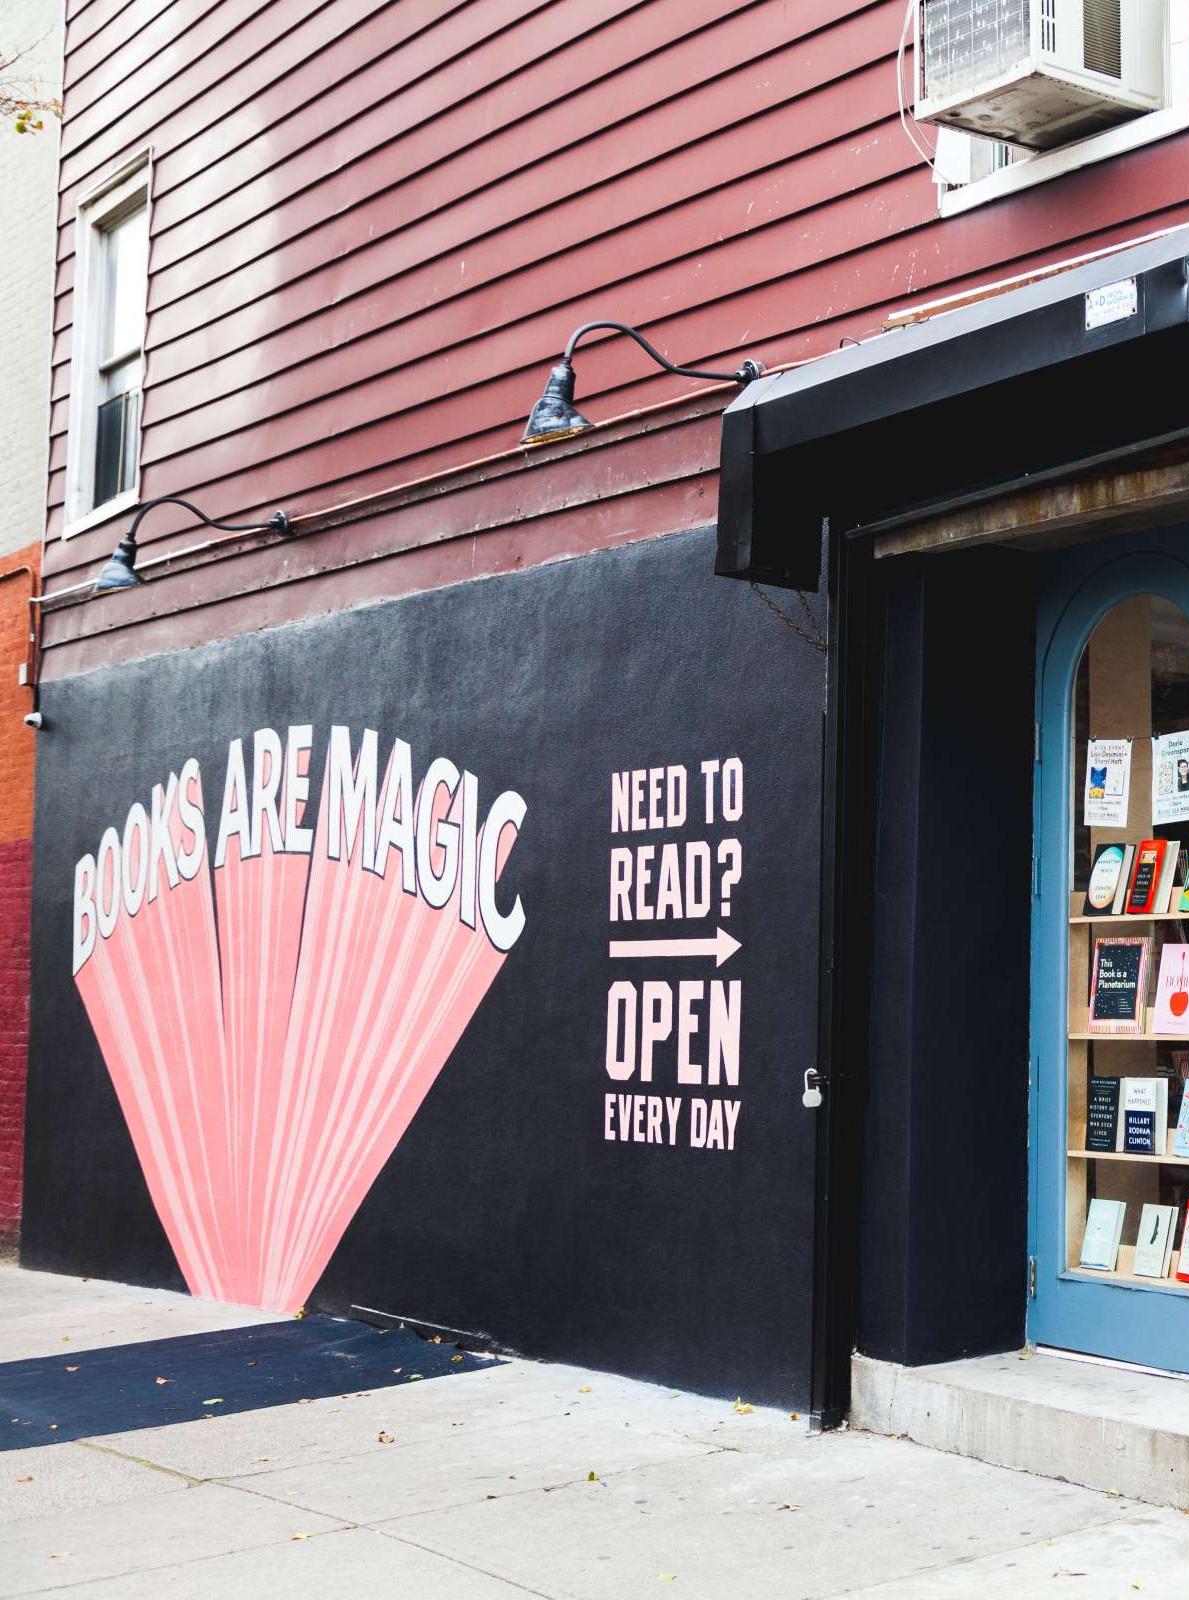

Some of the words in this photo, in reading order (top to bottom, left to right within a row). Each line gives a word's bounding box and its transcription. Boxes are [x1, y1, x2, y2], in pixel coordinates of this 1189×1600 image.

[611, 764, 687, 833] NEED
[701, 757, 743, 824] TO
[73, 758, 206, 976] BOOKS
[214, 725, 313, 868] ARE
[328, 725, 527, 951] MAGIC
[609, 838, 743, 922] READ?
[1099, 968, 1116, 978] Book
[1116, 969, 1122, 978] is
[1100, 958, 1113, 968] This
[1098, 979, 1136, 989] Planetarium
[605, 980, 741, 1085] OPEN
[604, 1093, 682, 1146] EVERY
[690, 1098, 741, 1151] DAY
[1128, 1116, 1150, 1125] HILLARY
[1128, 1137, 1151, 1146] CLINTON
